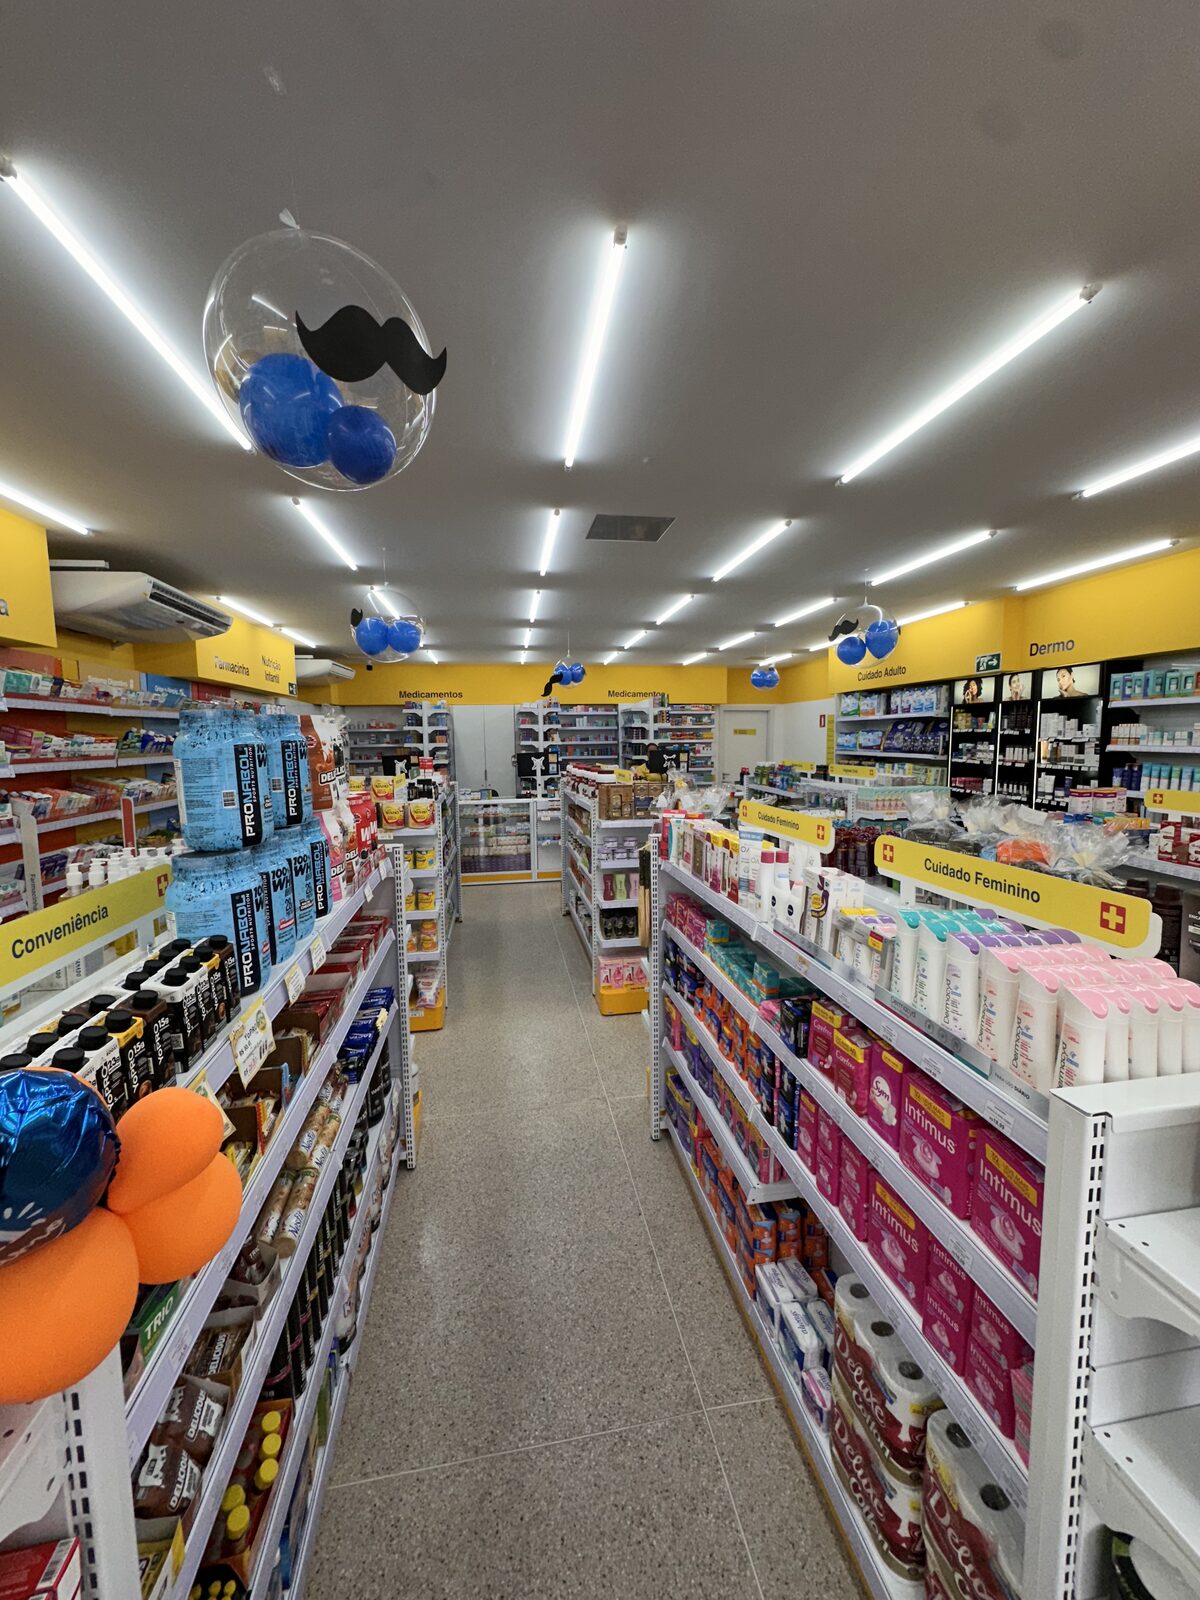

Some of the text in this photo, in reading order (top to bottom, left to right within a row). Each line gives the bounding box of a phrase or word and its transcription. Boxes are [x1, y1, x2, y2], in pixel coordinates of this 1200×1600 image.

[214, 656, 251, 677] Farmacinha
[1029, 639, 1075, 657] Dermo
[398, 690, 464, 699] Medicamentos
[857, 665, 907, 682] Cuidado Adulto
[239, 747, 257, 837] PRONABOL
[284, 742, 299, 817] PRONABOL
[757, 811, 800, 831] Cuidado Feminino
[923, 857, 1041, 904] Cuidado Feminino
[11, 904, 110, 960] Conveniência
[236, 894, 255, 988] PRONABOL
[159, 1017, 170, 1030] 15g
[943, 977, 953, 1025] Dermacyd
[132, 1041, 146, 1056] 15g
[1011, 1015, 1023, 1069] Dermacyd
[873, 1080, 891, 1103] Sym
[904, 1096, 957, 1156] Intimus
[979, 1158, 1042, 1238] Intimus
[871, 1192, 919, 1253] Intimus
[933, 1242, 967, 1281] Intimus
[144, 1295, 174, 1341] TRIO
[926, 1293, 960, 1334] Intimus
[975, 1290, 1010, 1335] Intimus
[834, 1323, 887, 1428] Deluxe
[970, 1343, 1004, 1392] Intimus
[851, 1389, 890, 1459] Cotton
[833, 1407, 887, 1523] Deluxe
[850, 1475, 889, 1551] Cotton
